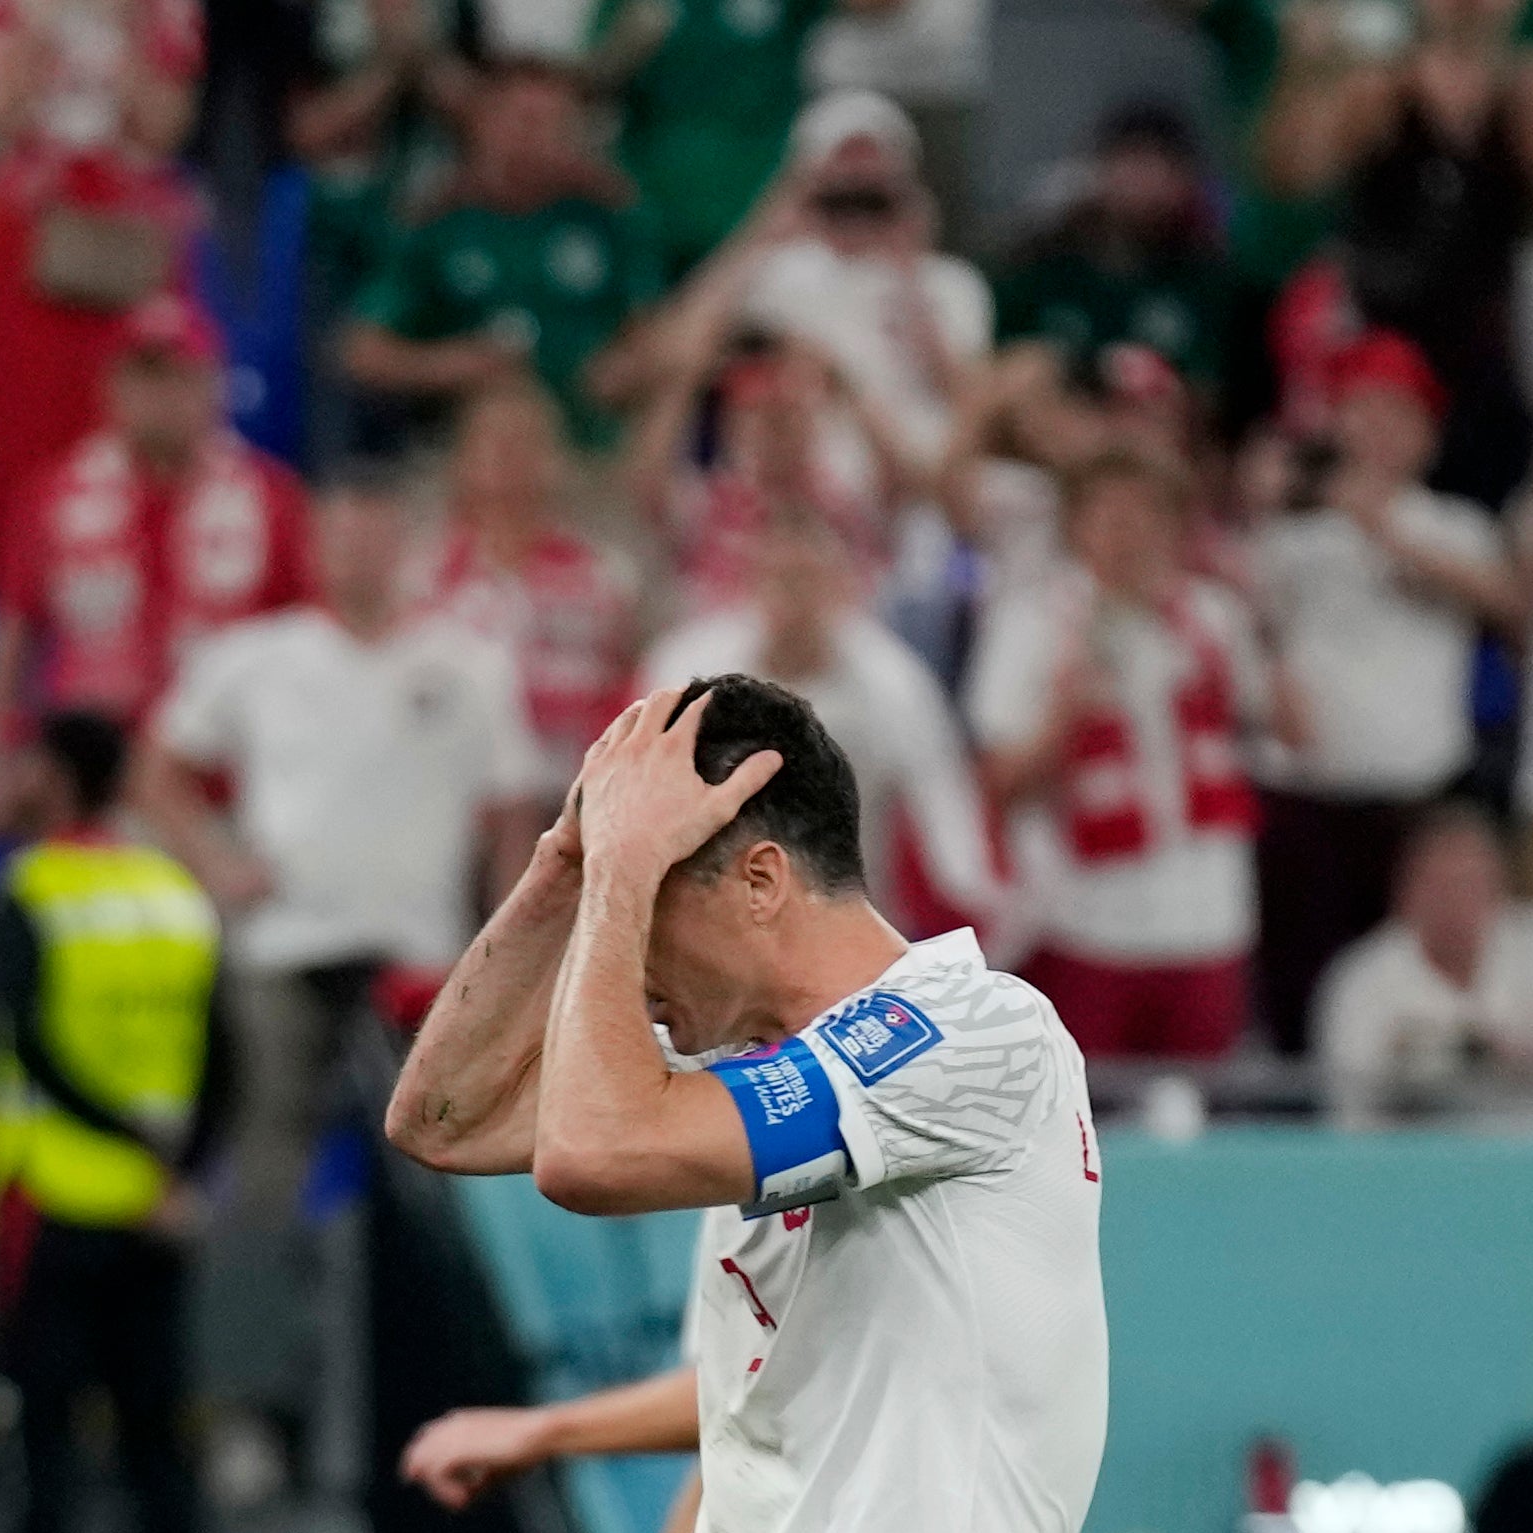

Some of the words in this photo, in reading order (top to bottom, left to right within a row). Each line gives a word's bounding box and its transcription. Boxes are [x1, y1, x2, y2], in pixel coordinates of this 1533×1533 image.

[754, 1085, 784, 1125] World
[758, 1063, 800, 1116] UNITES
[775, 1056, 813, 1108] FOOTBALL
